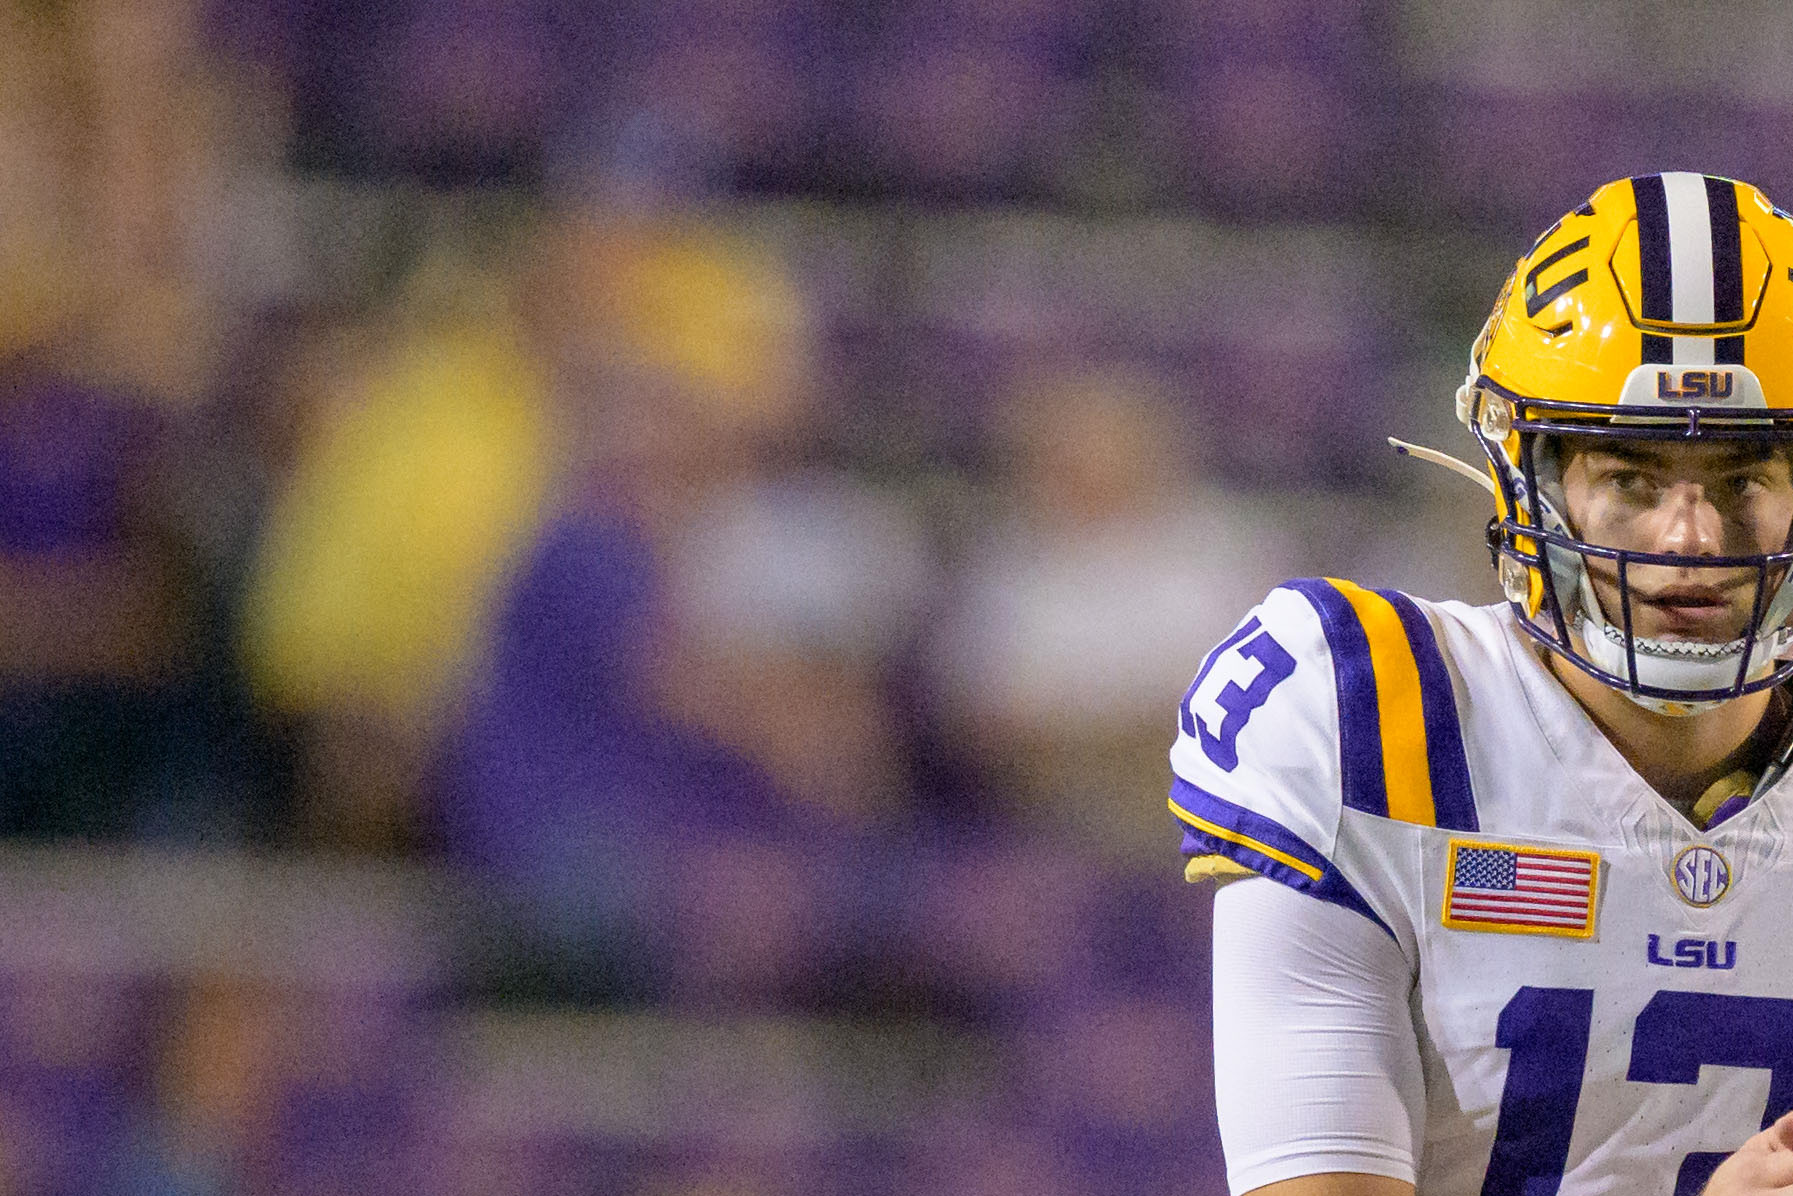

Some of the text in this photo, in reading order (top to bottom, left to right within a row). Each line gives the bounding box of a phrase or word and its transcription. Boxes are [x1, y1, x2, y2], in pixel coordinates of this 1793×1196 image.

[1658, 371, 1732, 400] LSU
[1679, 848, 1729, 904] SEC
[1647, 933, 1737, 970] LSU
